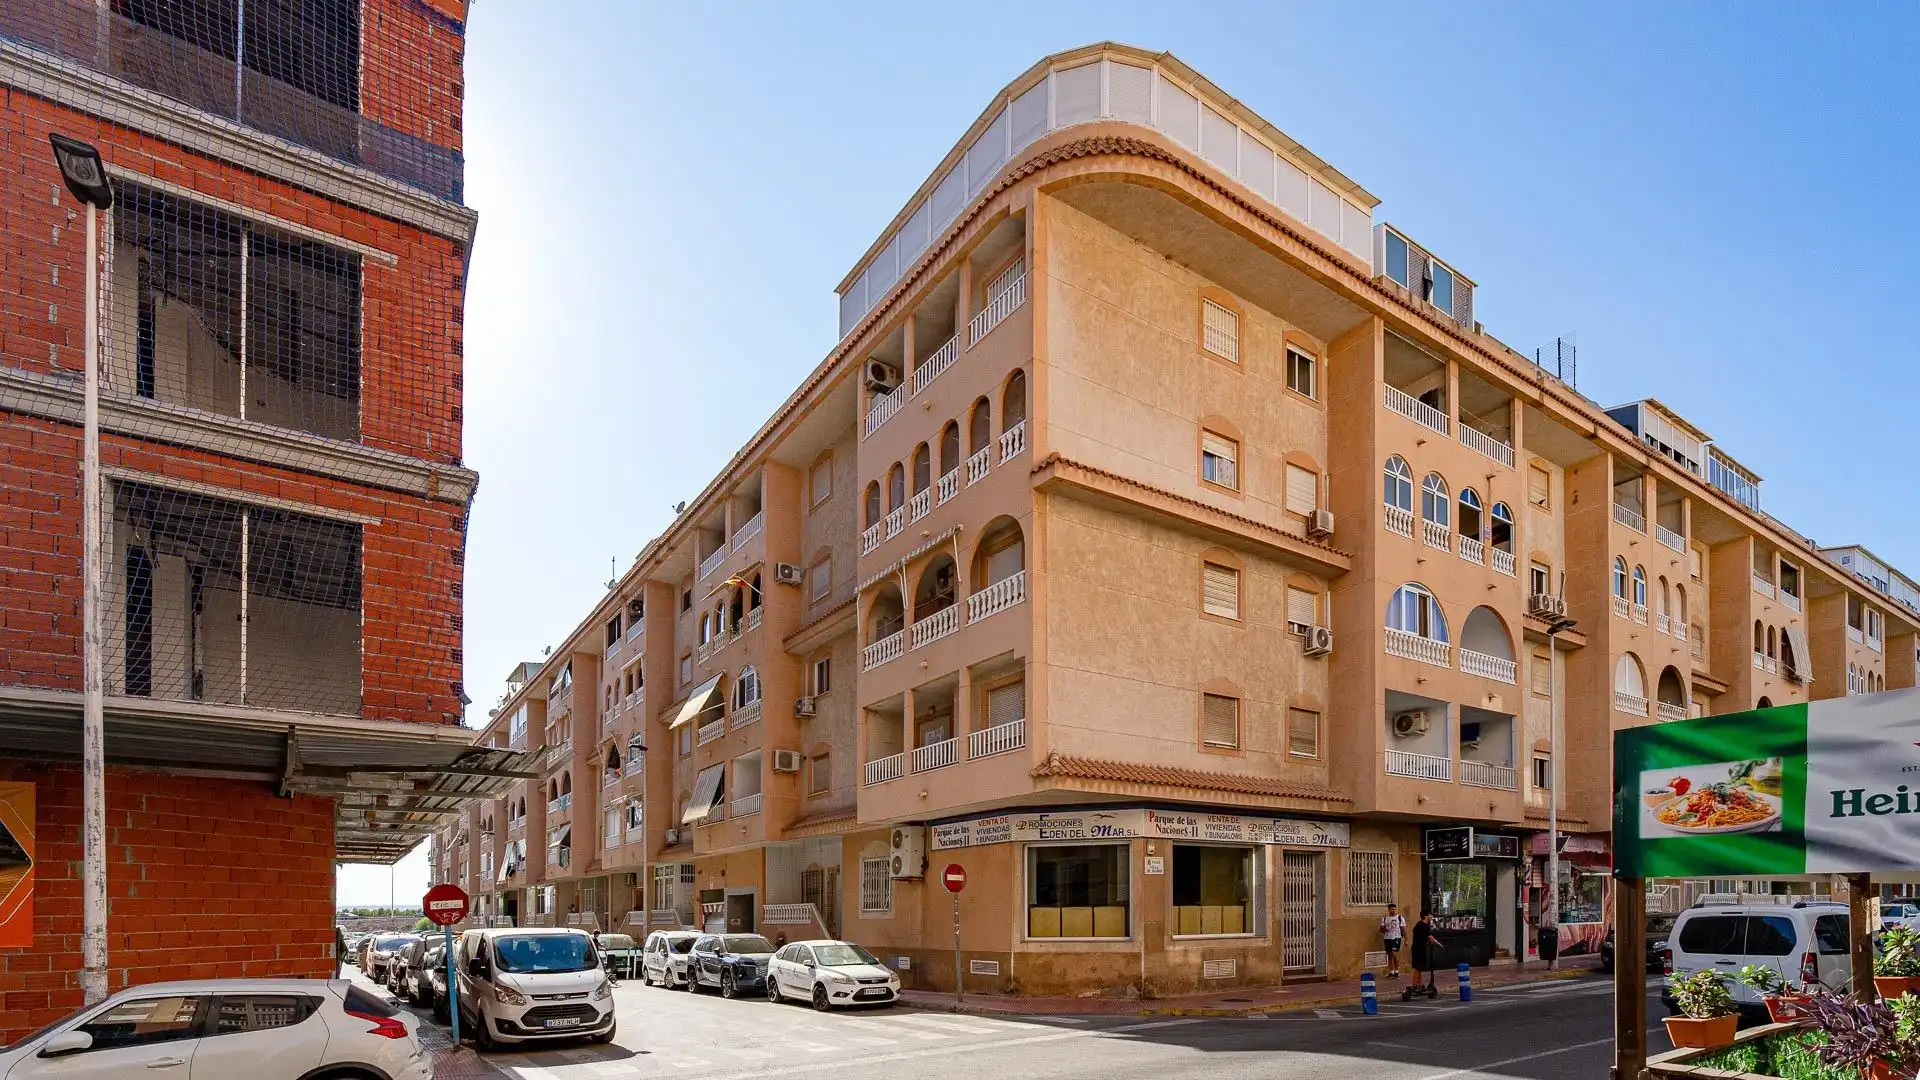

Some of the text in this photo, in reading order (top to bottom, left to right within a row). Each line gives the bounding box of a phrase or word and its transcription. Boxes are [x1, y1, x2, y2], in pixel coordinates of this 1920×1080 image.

[978, 816, 1009, 827] VENTA DE
[1149, 811, 1197, 826] Parque de las
[1207, 815, 1241, 824] VENTA DE
[1016, 820, 1083, 830] PROMOCIONES
[1205, 823, 1241, 832] VIVIENDAS
[1248, 823, 1301, 834] PROMOCIONES
[934, 825, 970, 838] Parque de las
[976, 825, 1010, 836] VIVIENDAS
[1069, 829, 1086, 838] DEL
[1208, 831, 1243, 840] BUNGALOWS
[979, 833, 1011, 844] BUNGALOWS
[1296, 836, 1308, 844] DEL
